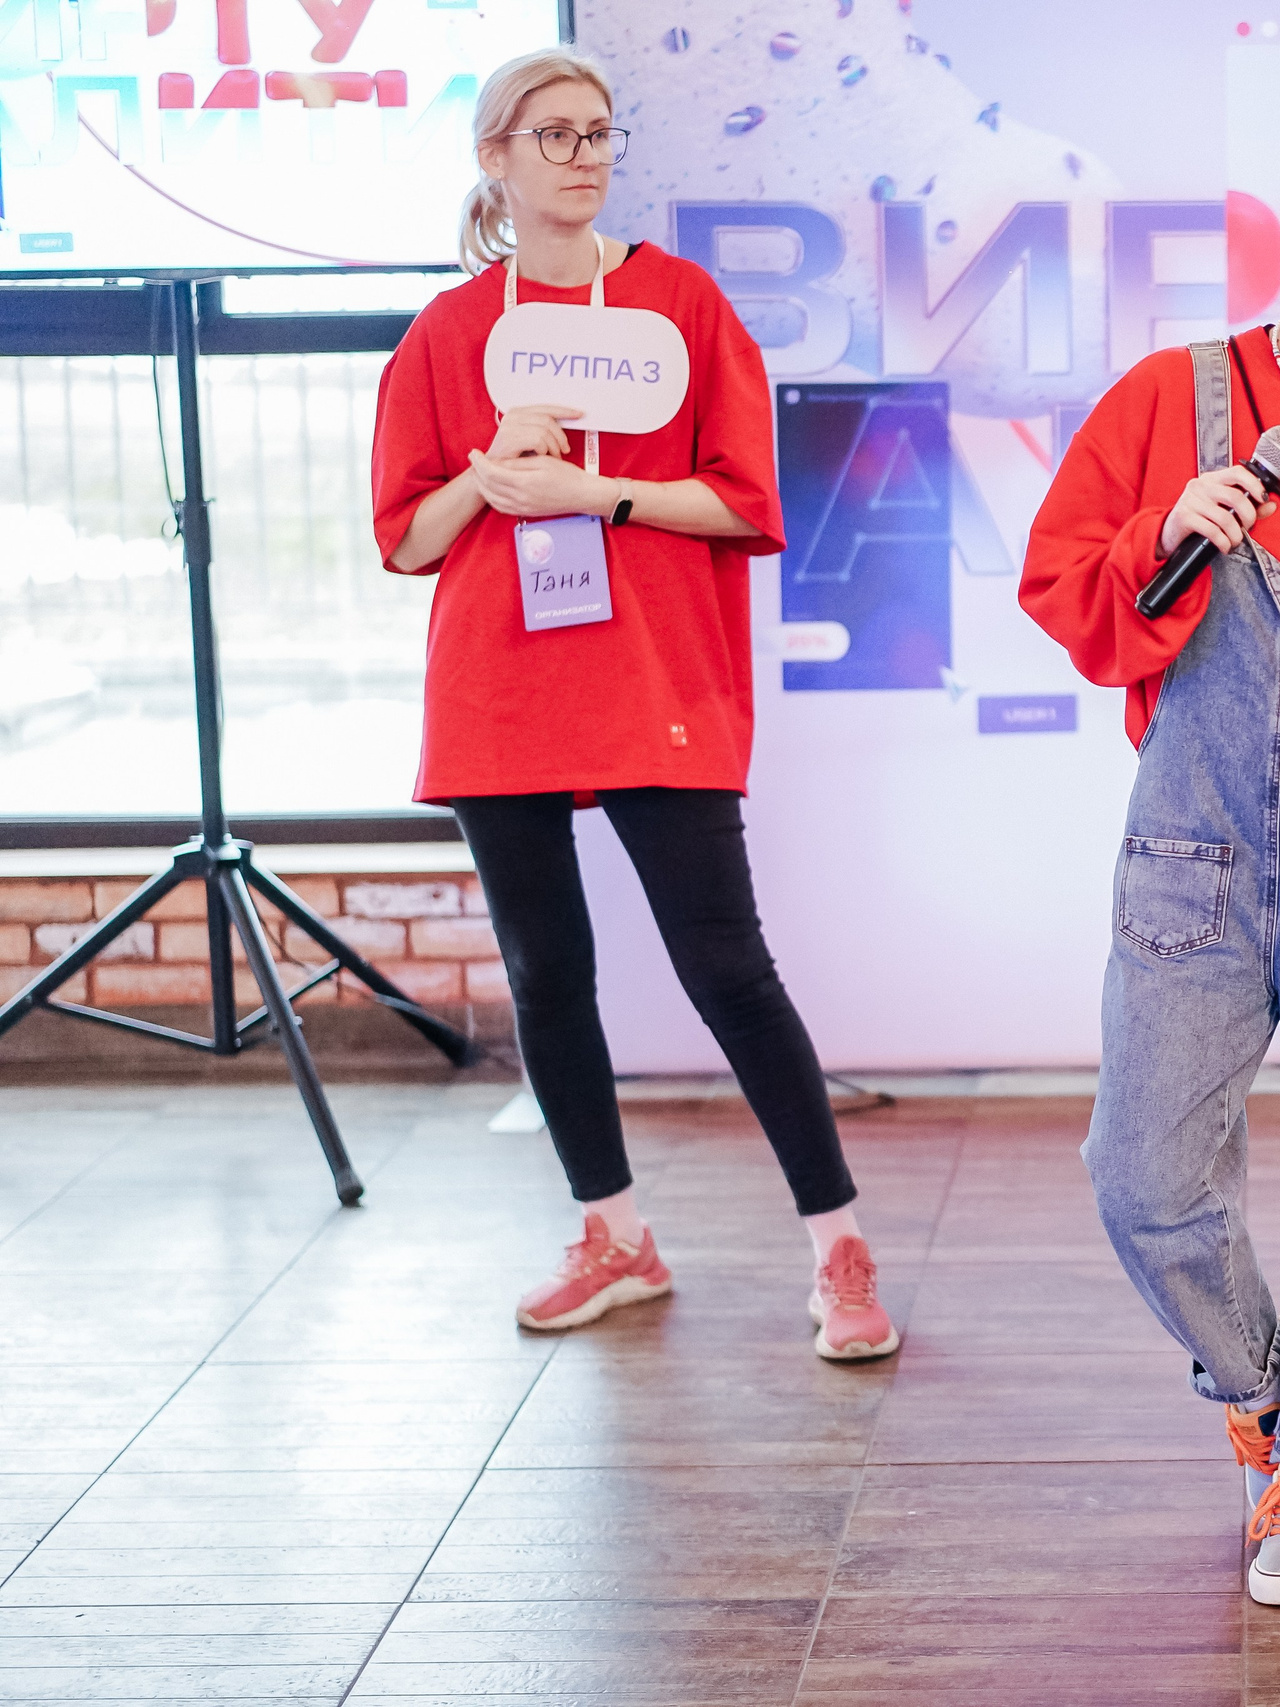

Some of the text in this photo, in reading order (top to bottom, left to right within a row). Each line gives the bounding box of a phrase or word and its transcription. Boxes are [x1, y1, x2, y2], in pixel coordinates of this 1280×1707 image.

[511, 351, 661, 384] ГРУППА 3
[530, 568, 590, 594] Таня
